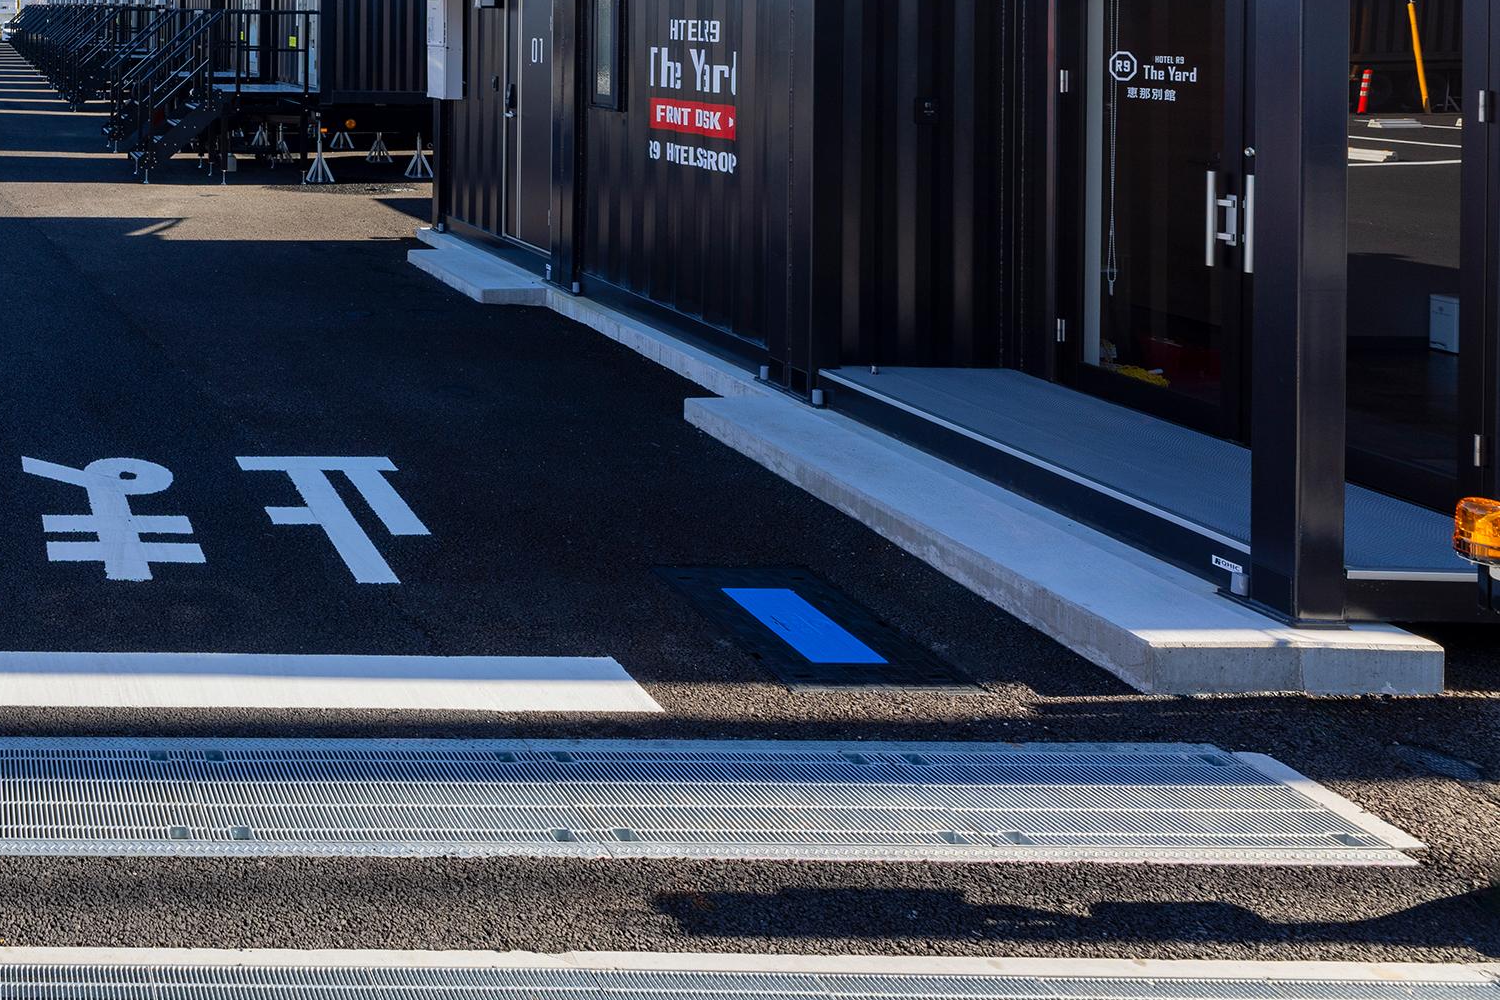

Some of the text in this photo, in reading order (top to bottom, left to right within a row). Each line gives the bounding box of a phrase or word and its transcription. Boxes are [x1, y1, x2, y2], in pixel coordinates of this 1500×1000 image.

[531, 37, 544, 64] 01
[1115, 60, 1131, 72] R9
[1155, 55, 1174, 64] HOTEL
[1143, 65, 1197, 82] The Yard
[1127, 87, 1176, 101] 恵那別館
